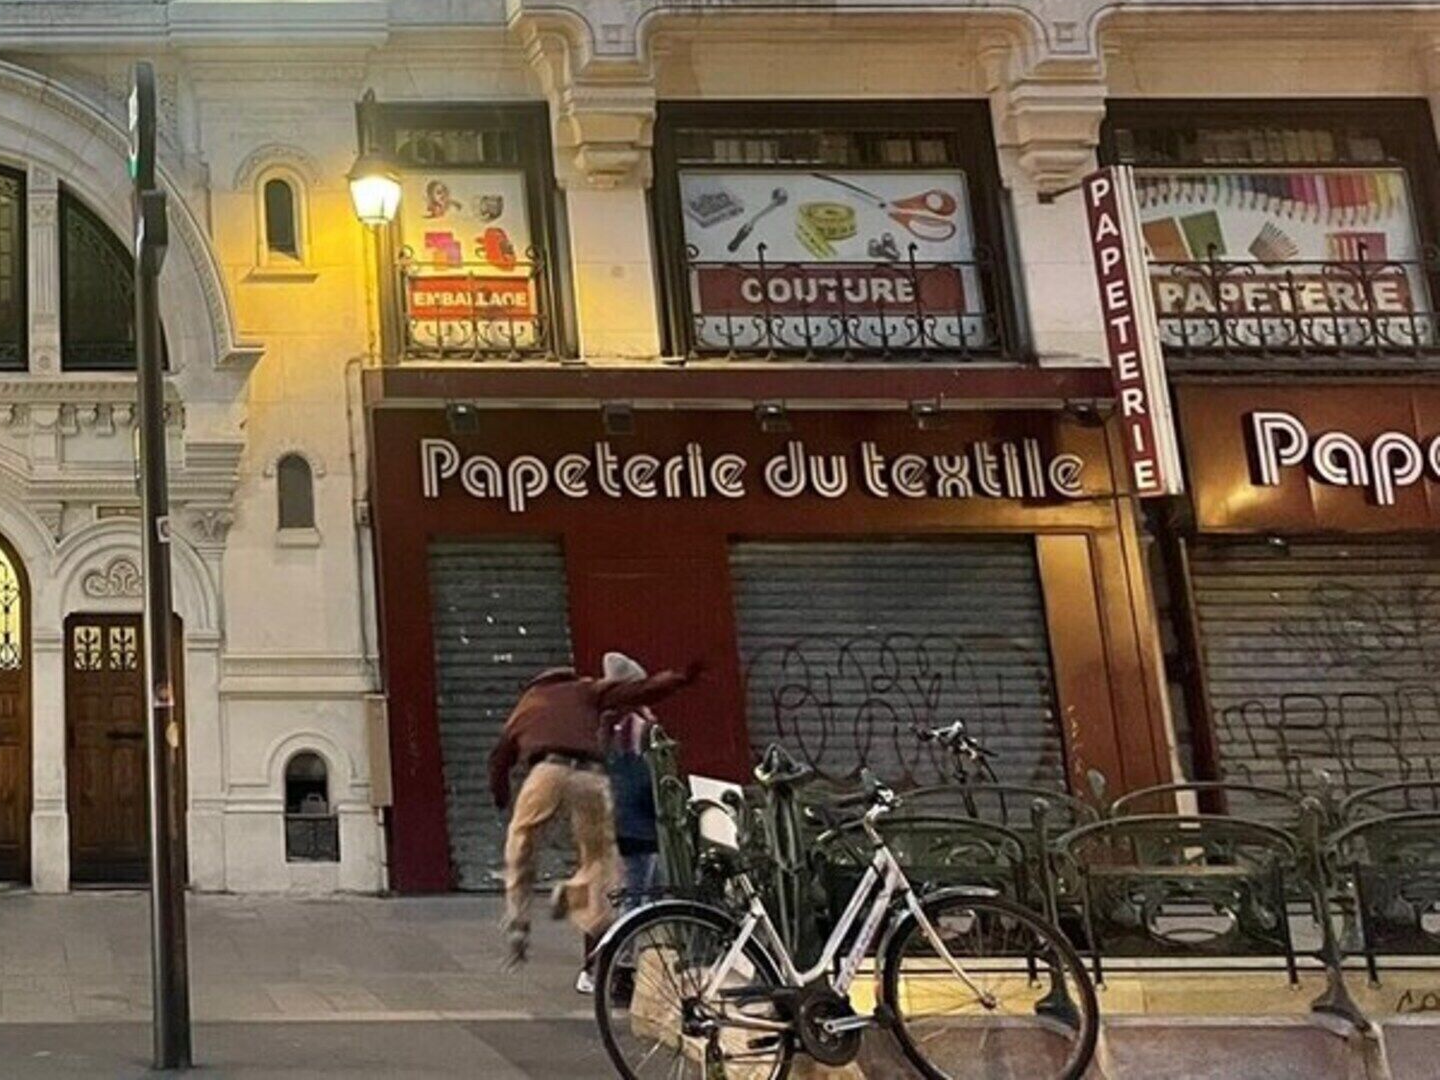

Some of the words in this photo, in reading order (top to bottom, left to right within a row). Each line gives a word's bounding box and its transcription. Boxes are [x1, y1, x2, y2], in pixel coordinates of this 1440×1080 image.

[740, 277, 916, 304] COUTURE
[1090, 177, 1158, 489] PAPETERIE
[420, 437, 748, 513] Papeterie
[764, 440, 848, 498] du
[862, 438, 1085, 498] textile
[1252, 411, 1440, 506] Pap
